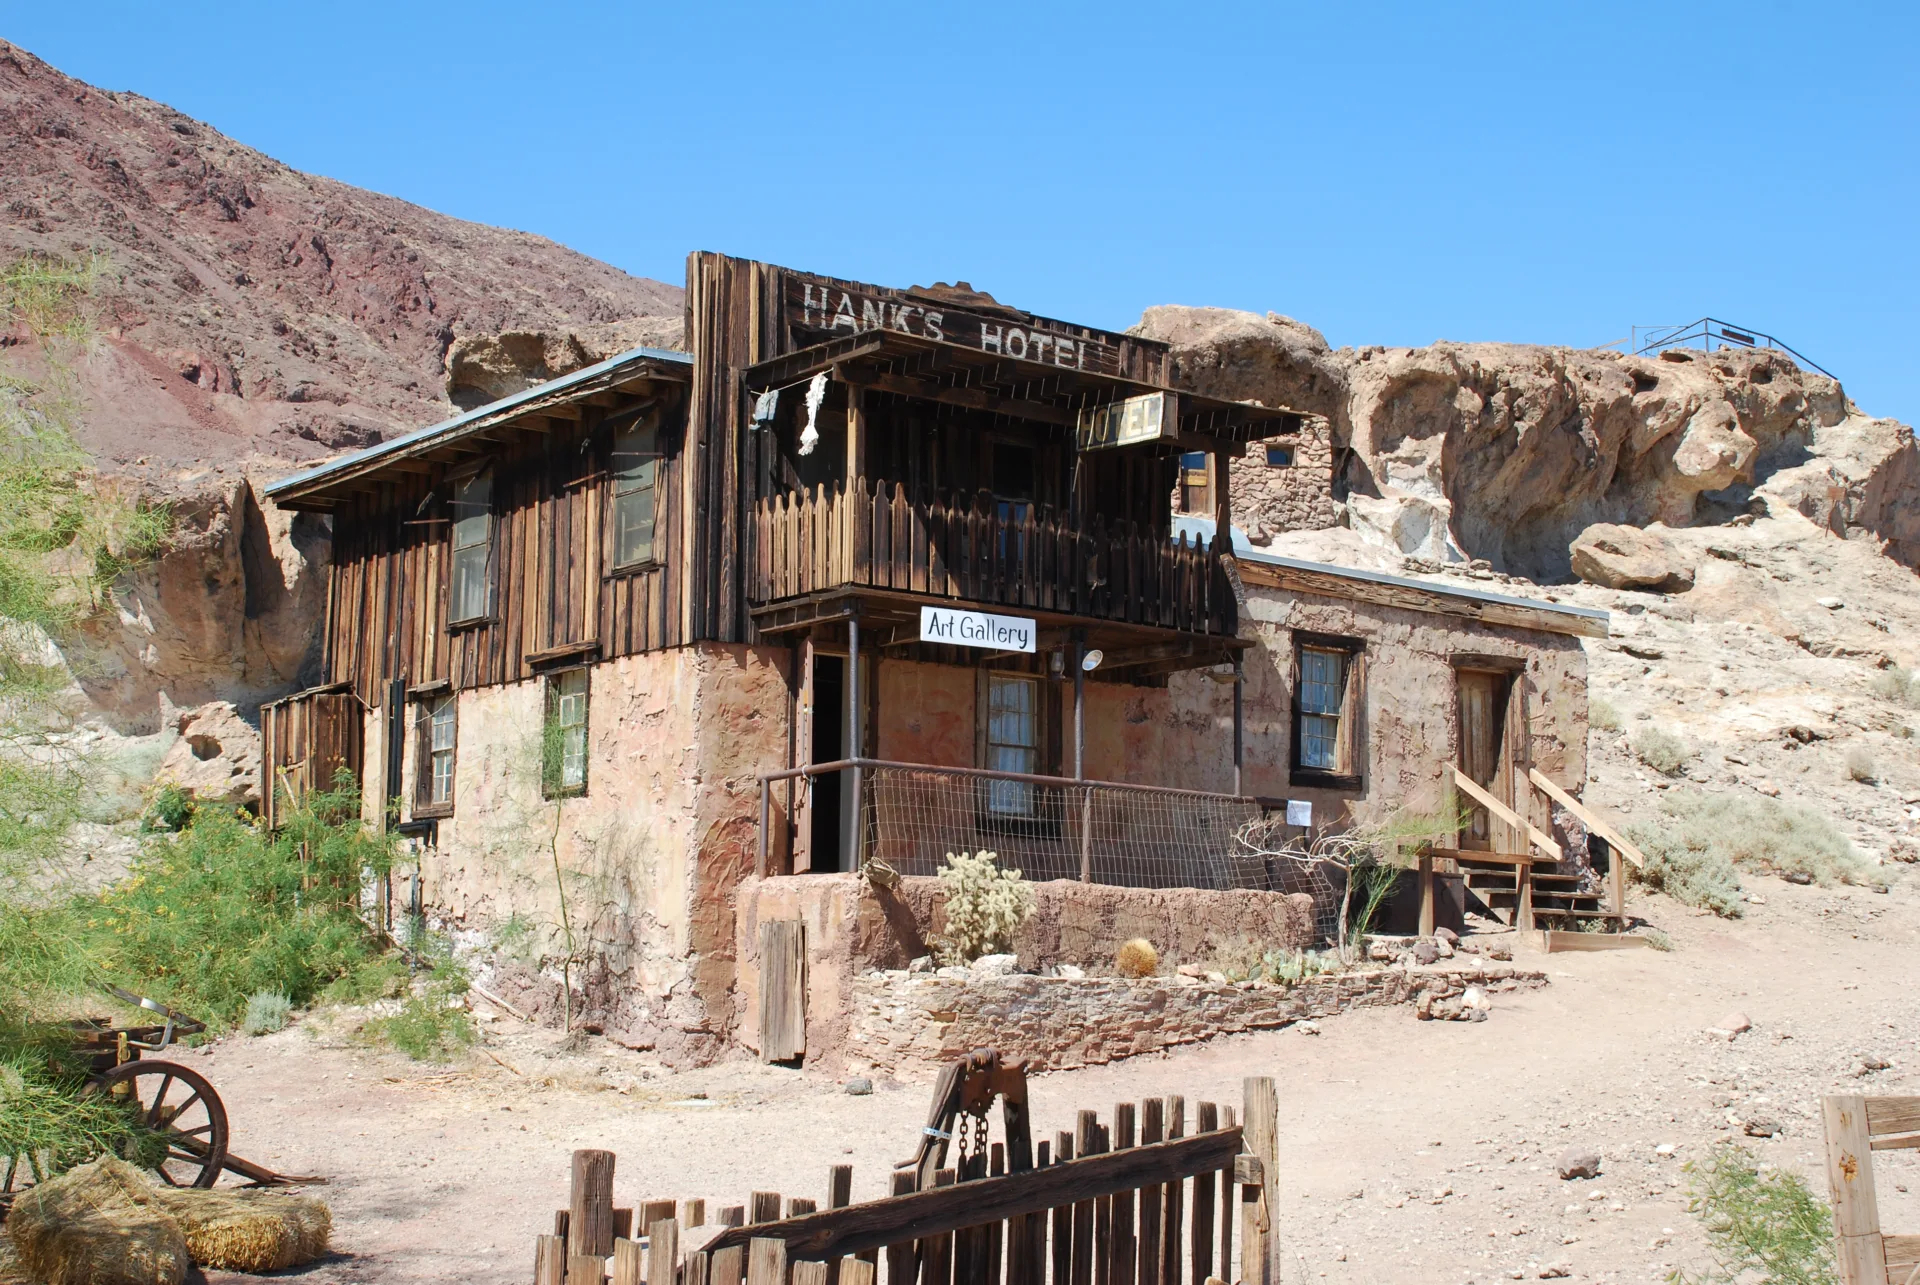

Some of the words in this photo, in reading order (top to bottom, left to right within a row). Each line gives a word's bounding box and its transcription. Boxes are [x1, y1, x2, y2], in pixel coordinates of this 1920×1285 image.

[803, 283, 944, 341] HANK'S
[1080, 399, 1158, 446] HOTEL
[928, 611, 954, 638] Art
[960, 616, 1028, 649] Gallery
